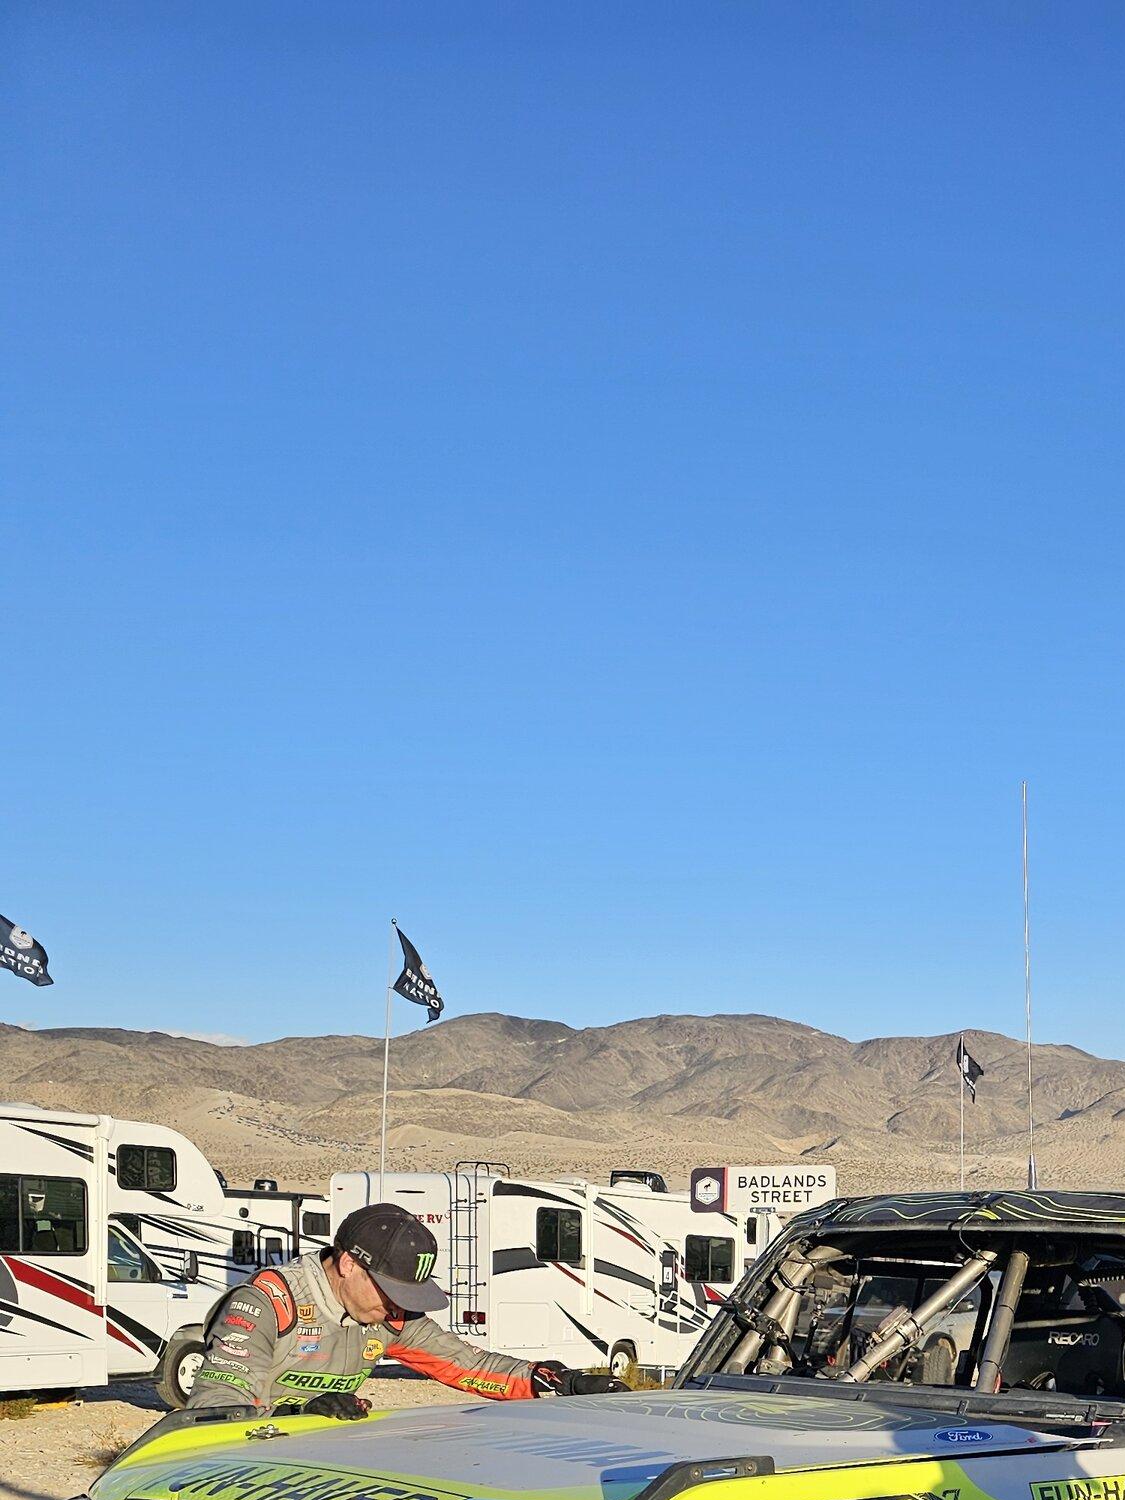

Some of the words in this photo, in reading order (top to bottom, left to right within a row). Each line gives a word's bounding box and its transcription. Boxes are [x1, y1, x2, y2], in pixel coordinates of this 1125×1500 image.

[738, 1175, 827, 1189] BADLANDS
[751, 1190, 813, 1203] STREET
[427, 1213, 443, 1224] RV
[1048, 1331, 1100, 1346] RECARO
[948, 1431, 983, 1442] Ford
